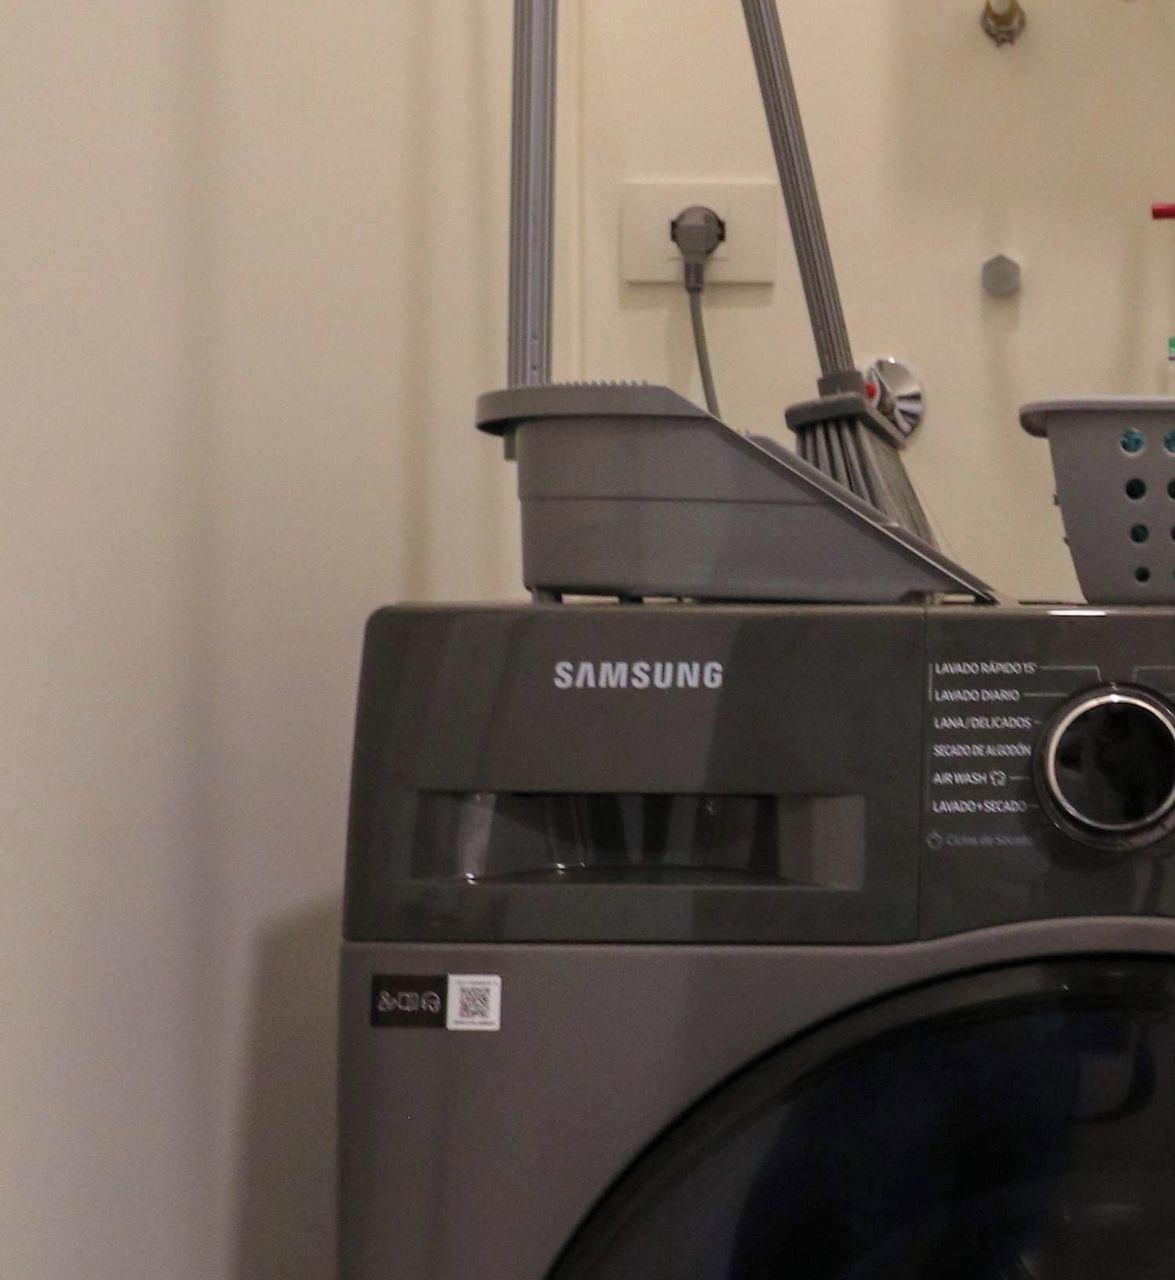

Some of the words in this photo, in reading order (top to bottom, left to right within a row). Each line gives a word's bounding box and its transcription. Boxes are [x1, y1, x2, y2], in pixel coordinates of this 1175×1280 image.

[935, 662, 980, 674] LAVADO
[554, 661, 723, 689] SAMSUNG
[934, 688, 980, 701] LAVADO
[980, 688, 1021, 701] DIARIO
[932, 744, 971, 757] SECADO
[971, 744, 985, 757] DE
[933, 771, 953, 785] AIR
[953, 771, 988, 785] WASH
